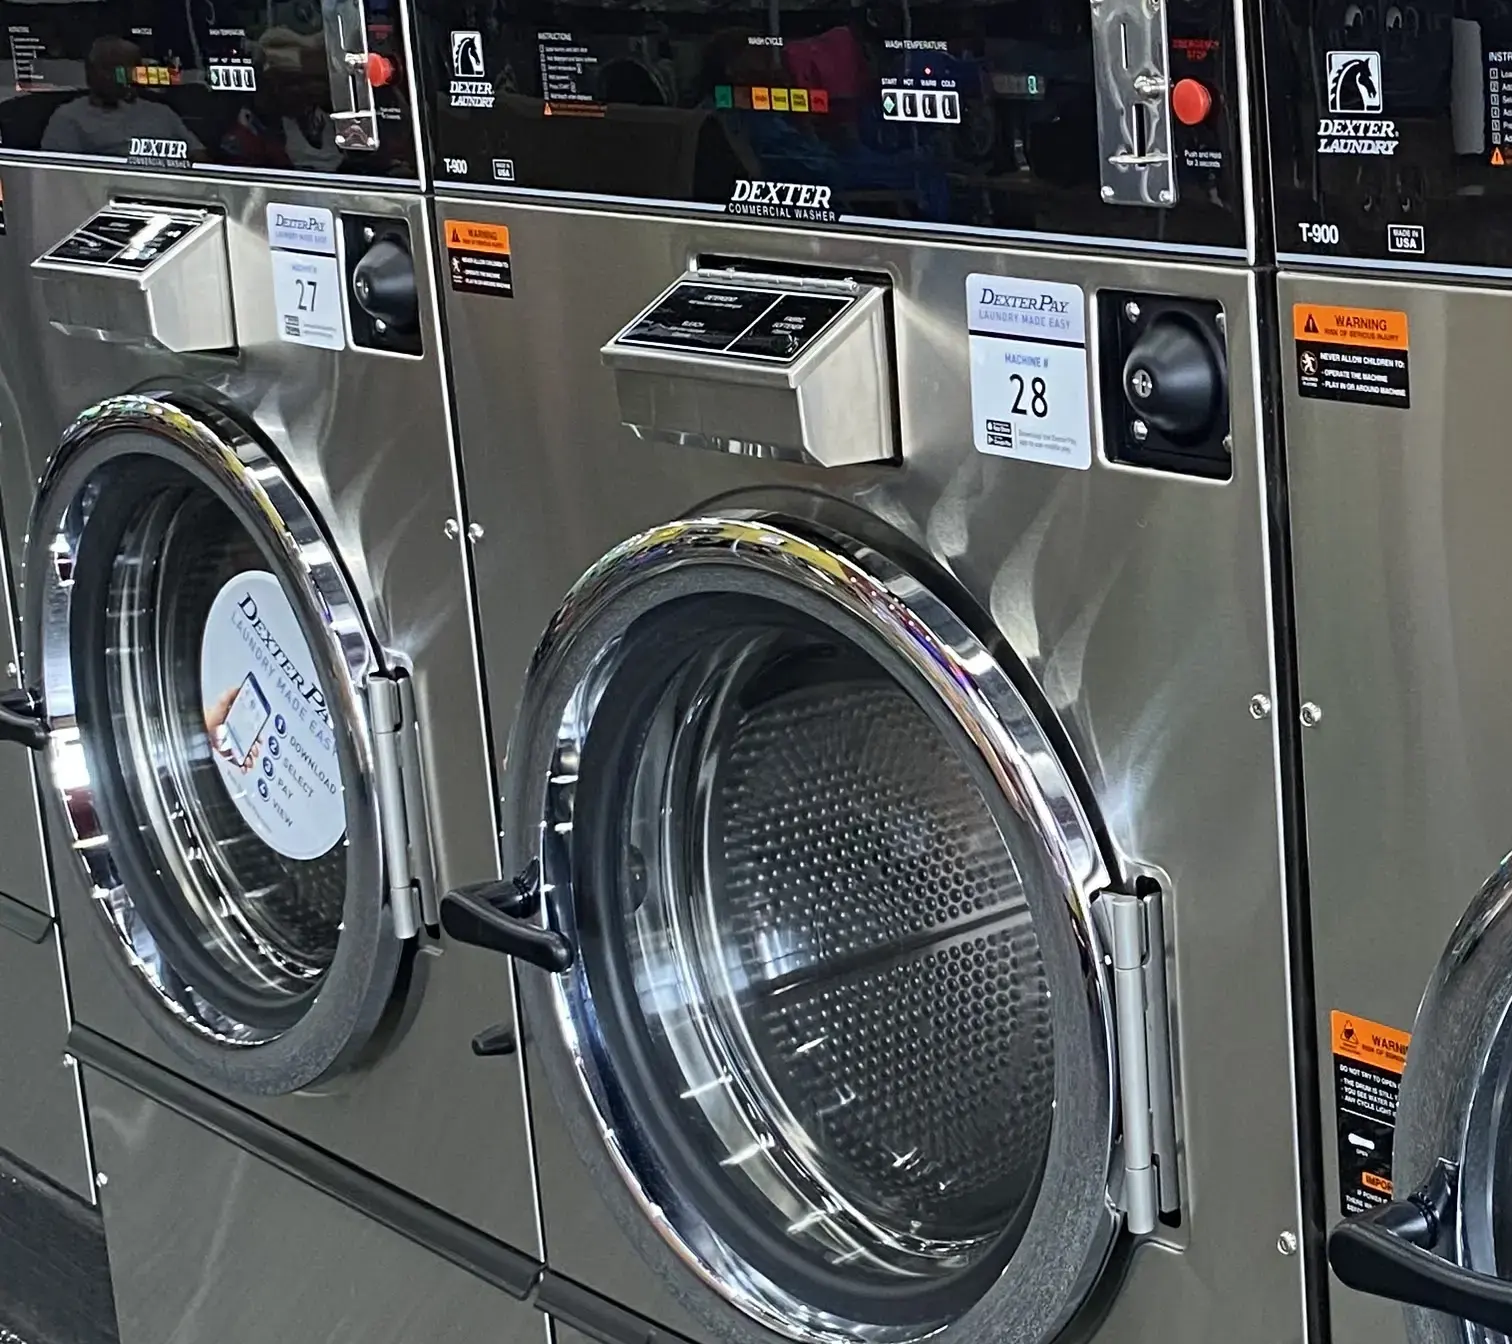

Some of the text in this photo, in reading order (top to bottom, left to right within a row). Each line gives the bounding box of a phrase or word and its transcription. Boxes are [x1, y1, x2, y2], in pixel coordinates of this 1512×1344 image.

[450, 81, 493, 94] DEXTER
[451, 96, 495, 107] LAUNDRY
[1317, 119, 1396, 137] DEXTER
[130, 138, 187, 159] DEXTER
[1317, 139, 1398, 155] LAUNDRY
[443, 158, 468, 174] T-900
[731, 180, 832, 208] DEXTER
[728, 203, 836, 222] COMMERCIAL WASHER
[1298, 223, 1339, 244] T-900
[1395, 237, 1417, 249] USA
[295, 279, 317, 312] 27
[978, 309, 1070, 330] LAUNDRY MADE EASY
[1335, 315, 1387, 331] WARNING
[1004, 352, 1041, 367] MACHINE
[1320, 352, 1340, 361] NEVER
[1341, 355, 1362, 364] ALLOW
[1363, 357, 1394, 367] CHILDREN
[1009, 373, 1048, 418] 28
[231, 609, 275, 677] LAUNDRY
[276, 676, 307, 722] MADE
[237, 592, 333, 726] DEXTERPA
[289, 736, 337, 795] DOWNLOAD
[282, 757, 314, 798] SELECT
[277, 778, 293, 800] PAY
[272, 798, 293, 827] VIEW
